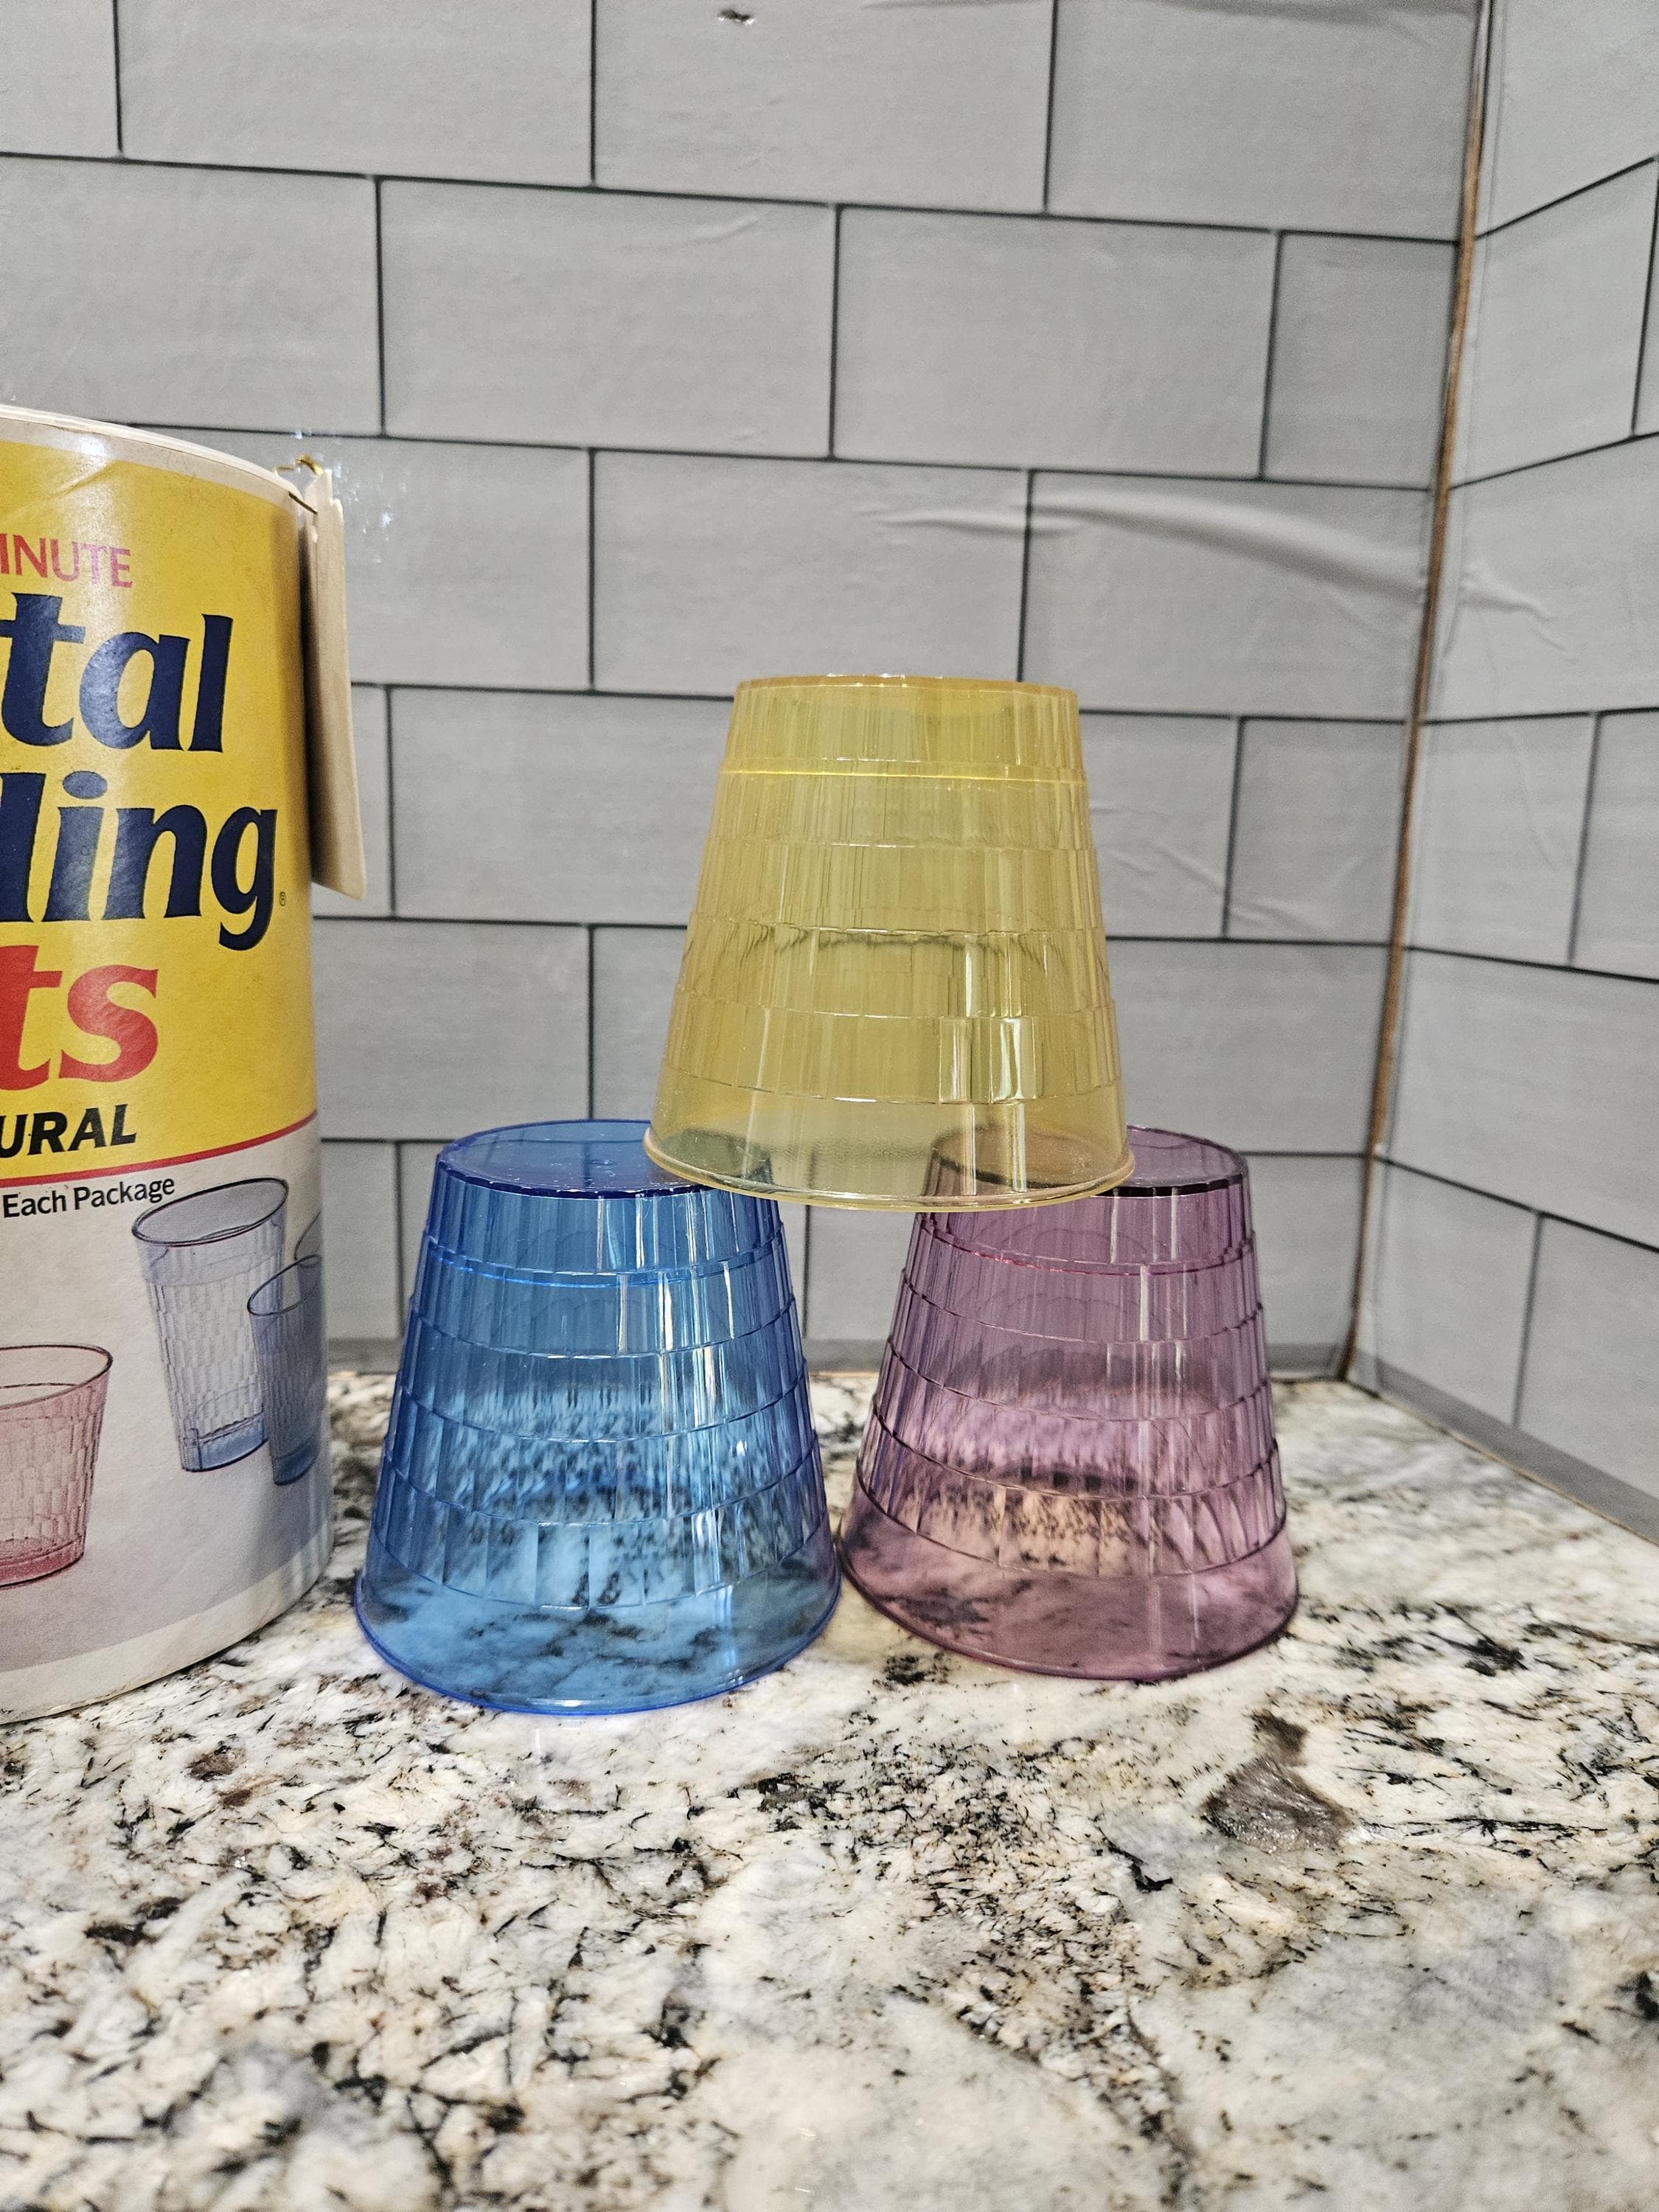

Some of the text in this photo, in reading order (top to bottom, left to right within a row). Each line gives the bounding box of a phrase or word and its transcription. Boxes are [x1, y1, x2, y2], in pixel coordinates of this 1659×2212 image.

[0, 592, 233, 753] tal
[2, 1178, 175, 1218] Each Package
